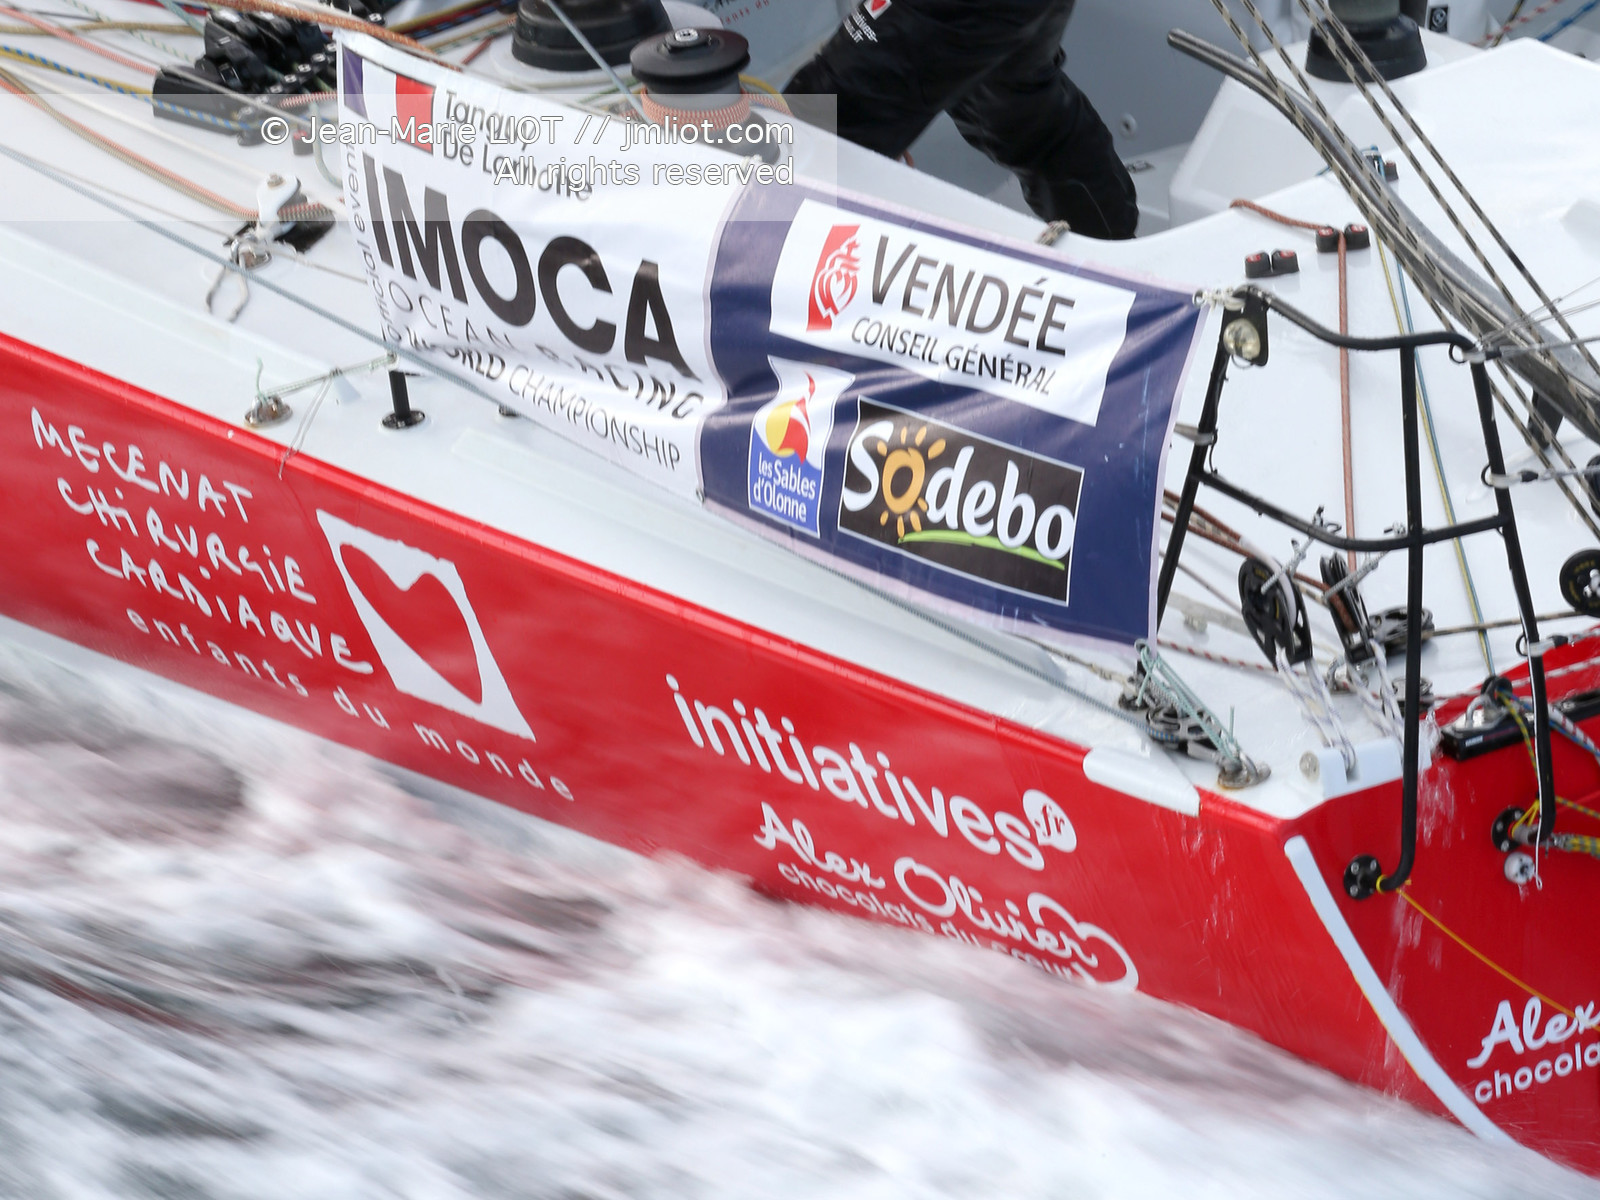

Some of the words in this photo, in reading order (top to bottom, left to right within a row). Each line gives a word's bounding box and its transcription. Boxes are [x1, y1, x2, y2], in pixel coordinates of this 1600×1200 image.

[443, 130, 474, 167] De
[362, 152, 702, 384] IMOCA
[389, 281, 516, 351] OCEAN
[872, 234, 1075, 357] VENDÉE
[851, 317, 939, 366] CONSEIL
[945, 344, 1056, 395] GÉNÉRAL
[31, 407, 253, 523] MECENAT
[508, 364, 681, 471] CHAMPIONSHIP
[753, 476, 807, 523] d'Olonne
[758, 452, 773, 479] les
[773, 459, 816, 500] Sables
[843, 421, 1074, 560] Sodebo
[126, 609, 309, 697] enfants
[333, 686, 390, 731] du
[413, 722, 575, 802] monde
[666, 673, 1045, 871] initiatives
[753, 802, 885, 889] Alex
[893, 857, 1099, 968] Olivier
[778, 862, 935, 935] chocolats
[1466, 996, 1600, 1069] Alex
